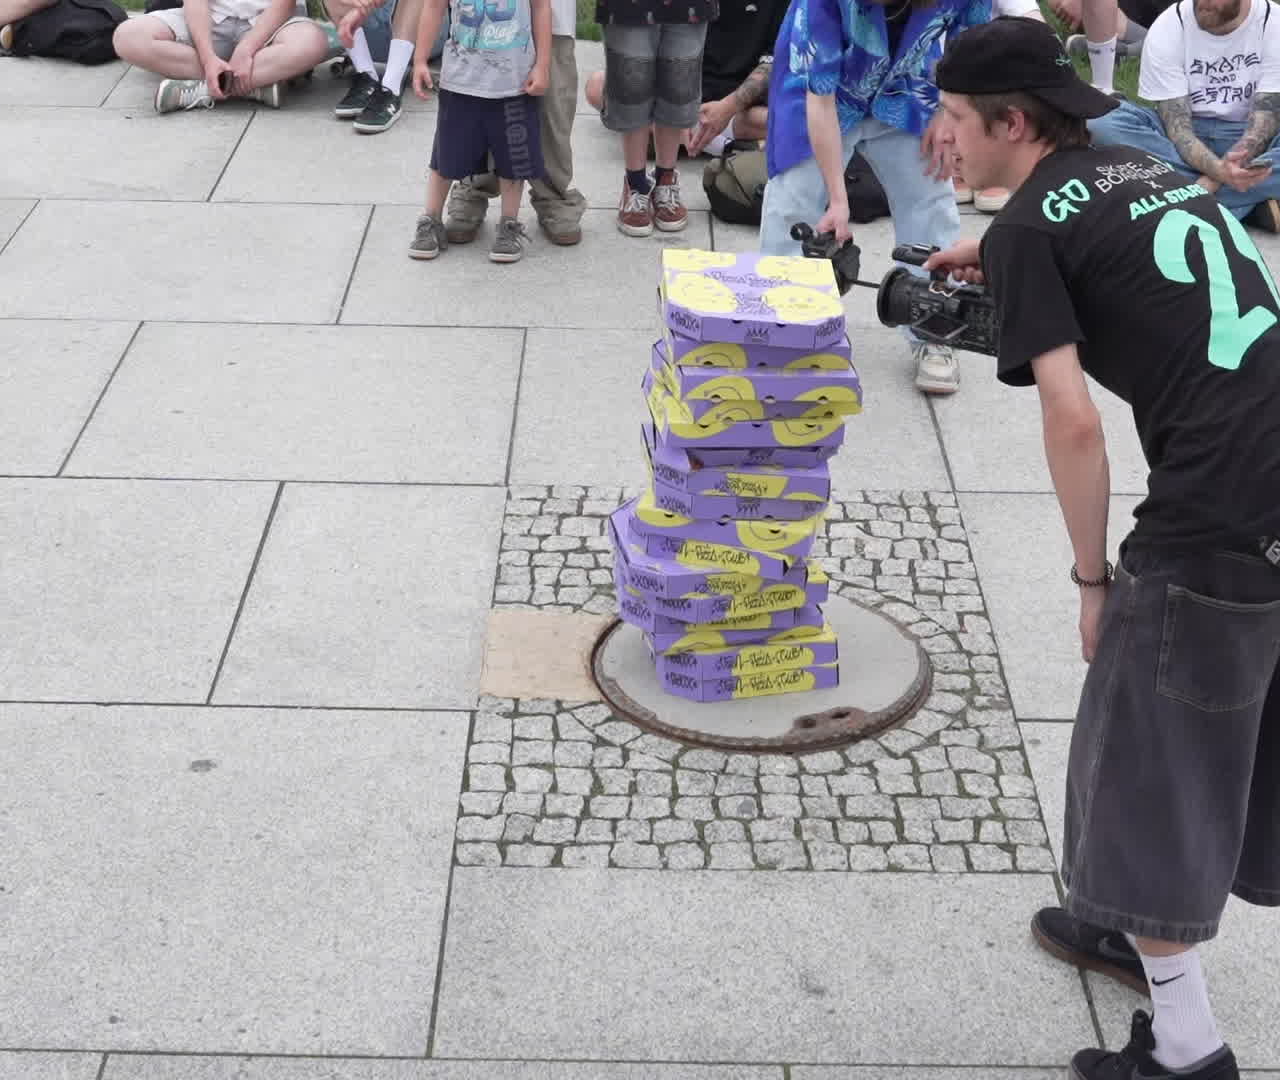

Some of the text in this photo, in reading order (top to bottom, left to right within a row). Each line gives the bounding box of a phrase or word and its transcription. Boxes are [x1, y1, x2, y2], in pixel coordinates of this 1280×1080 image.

[1190, 52, 1261, 76] SKATE
[1209, 74, 1236, 84] AND
[1190, 81, 1258, 105] ESTRO
[1042, 179, 1090, 223] GO
[1129, 194, 1167, 221] ALL
